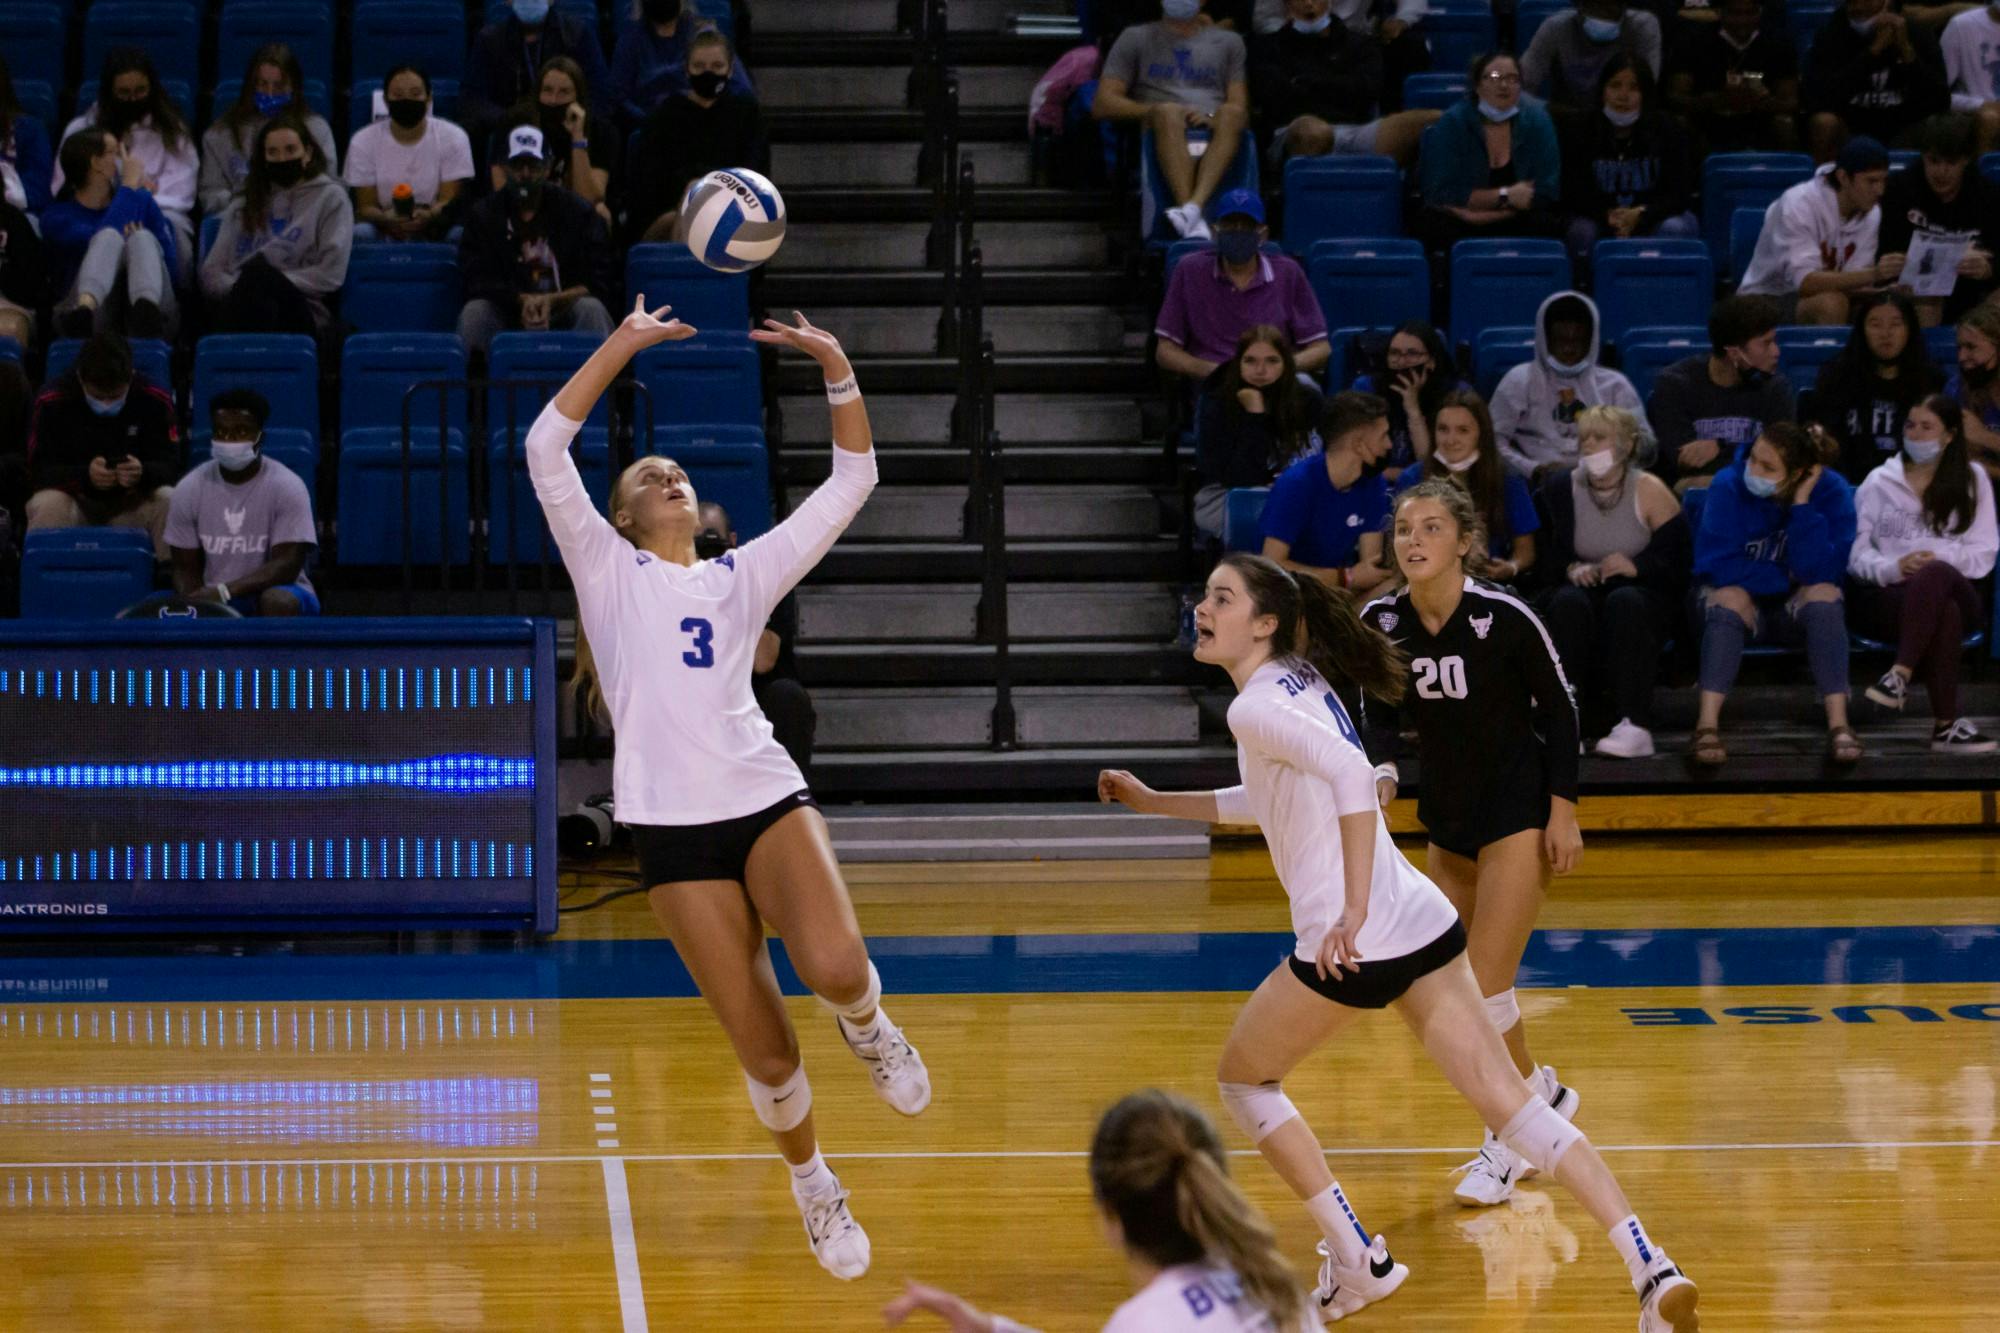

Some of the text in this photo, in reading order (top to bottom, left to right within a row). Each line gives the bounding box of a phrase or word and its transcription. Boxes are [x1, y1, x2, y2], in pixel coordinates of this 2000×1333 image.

[713, 172, 759, 210] molten
[680, 616, 715, 669] 3
[1411, 655, 1469, 700] 20
[0, 903, 109, 915] AKTRONICS
